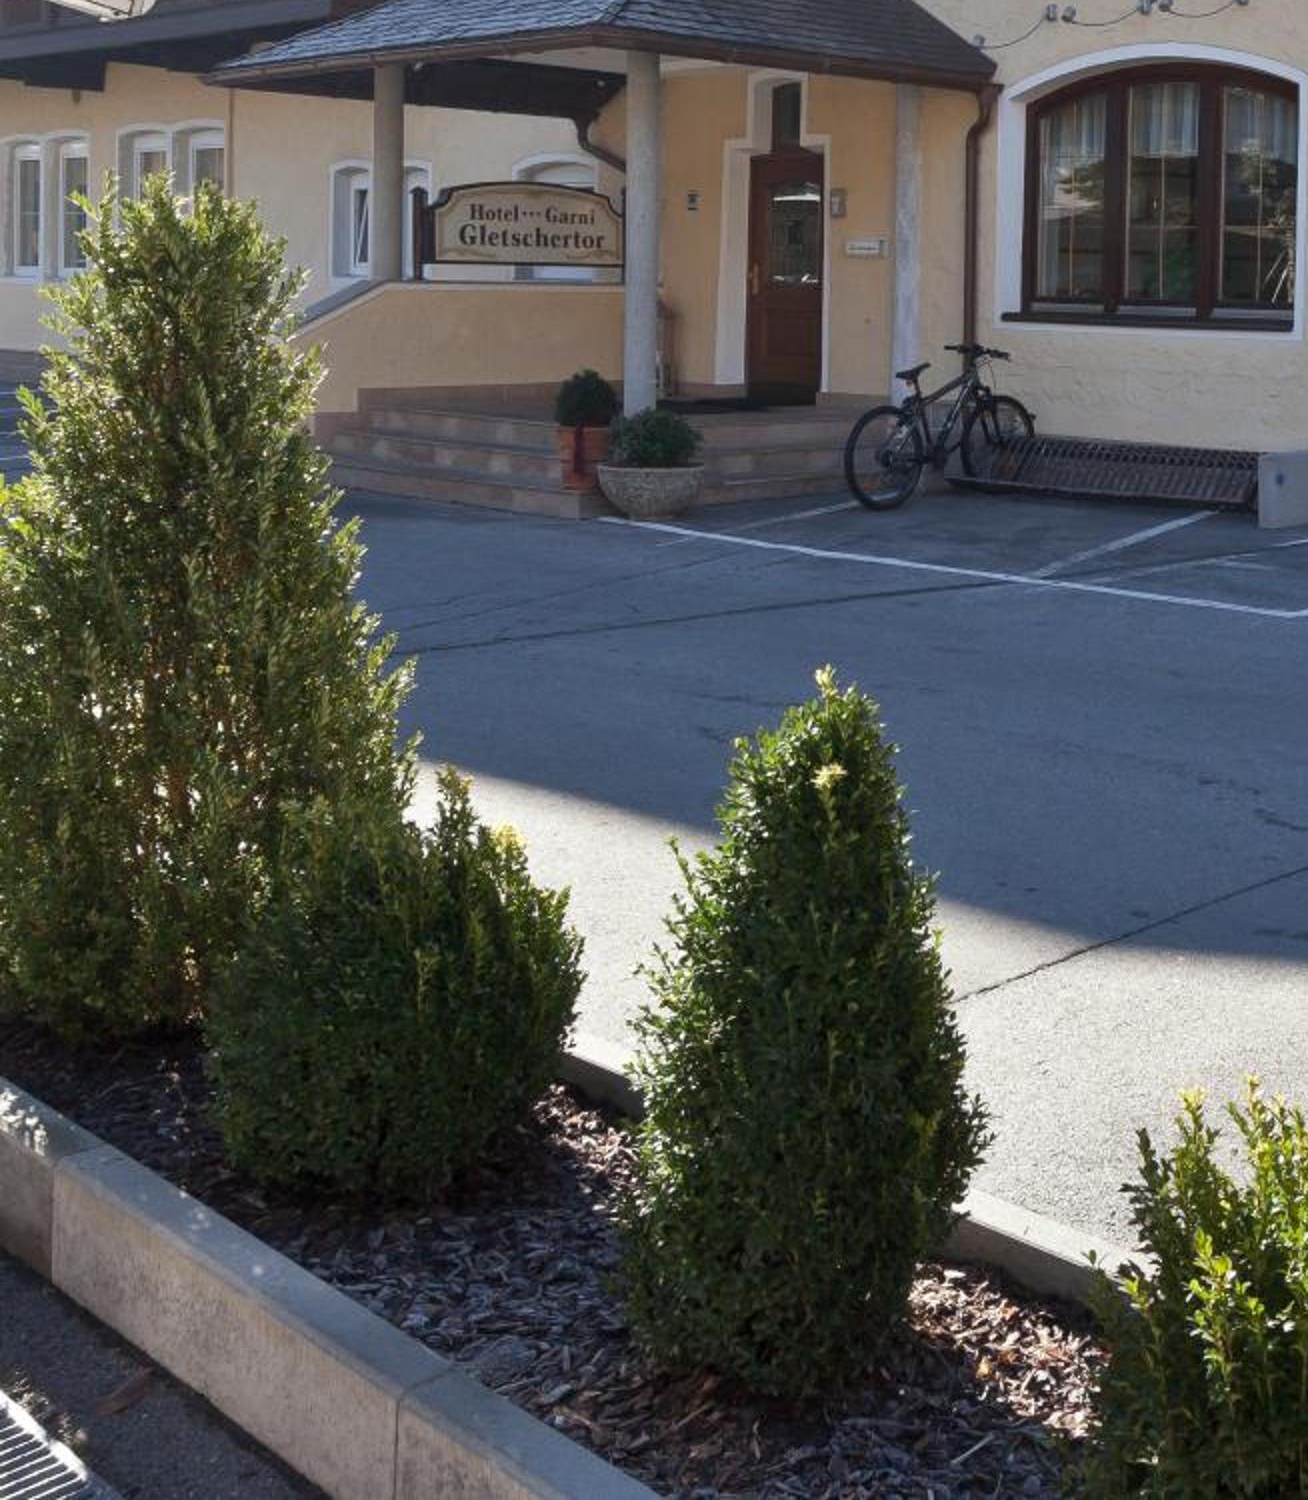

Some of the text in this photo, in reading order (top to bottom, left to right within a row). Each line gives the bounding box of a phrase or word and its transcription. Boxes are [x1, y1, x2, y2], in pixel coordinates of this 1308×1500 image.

[470, 204, 595, 225] Hotel Garni
[459, 224, 605, 249] Gletschertor
